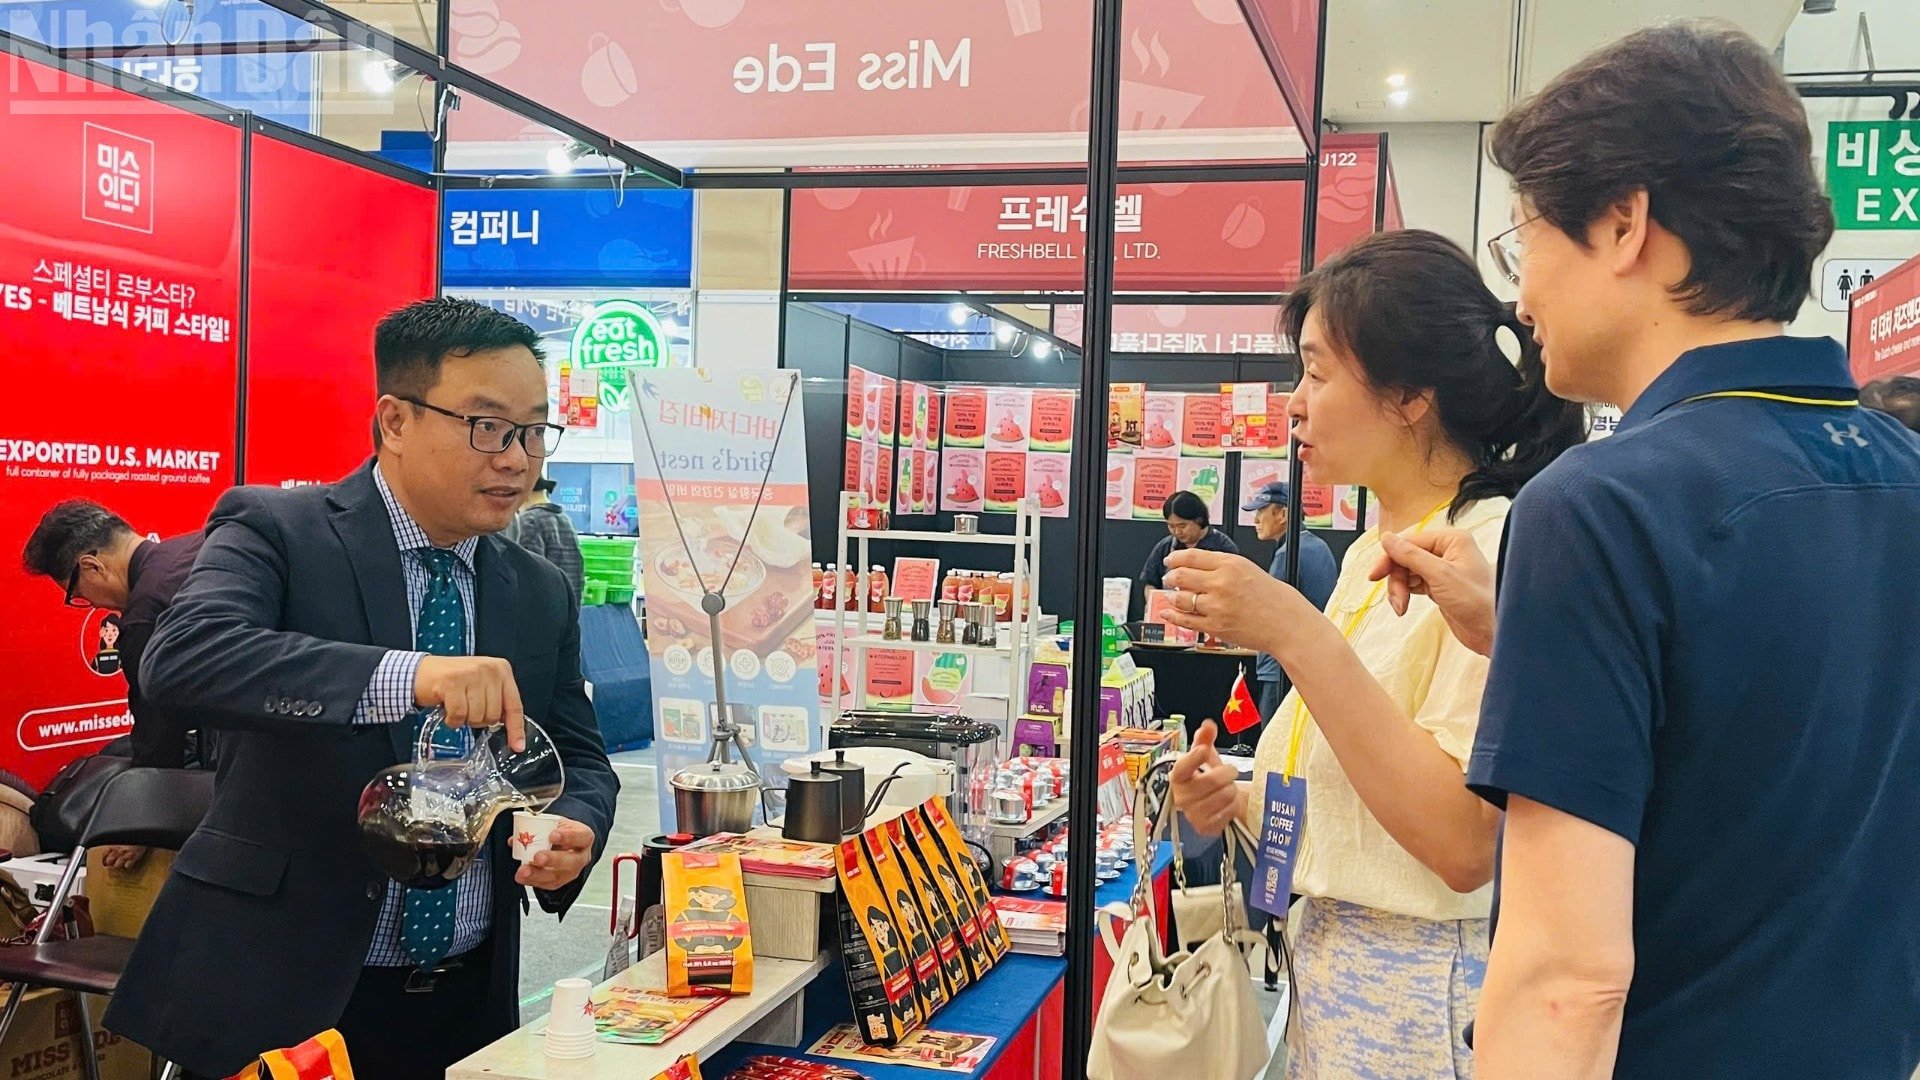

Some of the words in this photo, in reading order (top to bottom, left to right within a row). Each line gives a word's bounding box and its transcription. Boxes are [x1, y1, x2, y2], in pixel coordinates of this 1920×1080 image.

[98, 143, 140, 179] 미스
[1320, 152, 1357, 167] J122
[1857, 188, 1919, 221] EX
[449, 209, 541, 246] 컴퍼니
[977, 242, 1077, 260] FRESHBELL
[1124, 242, 1161, 260] LTD.
[32, 259, 111, 296] 스페셜티
[117, 273, 196, 309] 로부스타?
[53, 291, 129, 329] 베트남식
[134, 305, 169, 335] 커피
[173, 313, 230, 343] 스타일!
[591, 316, 638, 339] eat
[582, 333, 655, 364] fresh
[0, 439, 101, 465] EXPORTED
[106, 446, 141, 467] U.S.
[146, 448, 220, 471] MARKET
[21, 467, 60, 478] container
[131, 472, 160, 482] roasted
[161, 473, 187, 485] ground
[1270, 816, 1294, 832] COFFEE
[1271, 800, 1296, 817] BUSAN
[1267, 830, 1292, 846] SHOW
[11, 1041, 70, 1077] MISS
